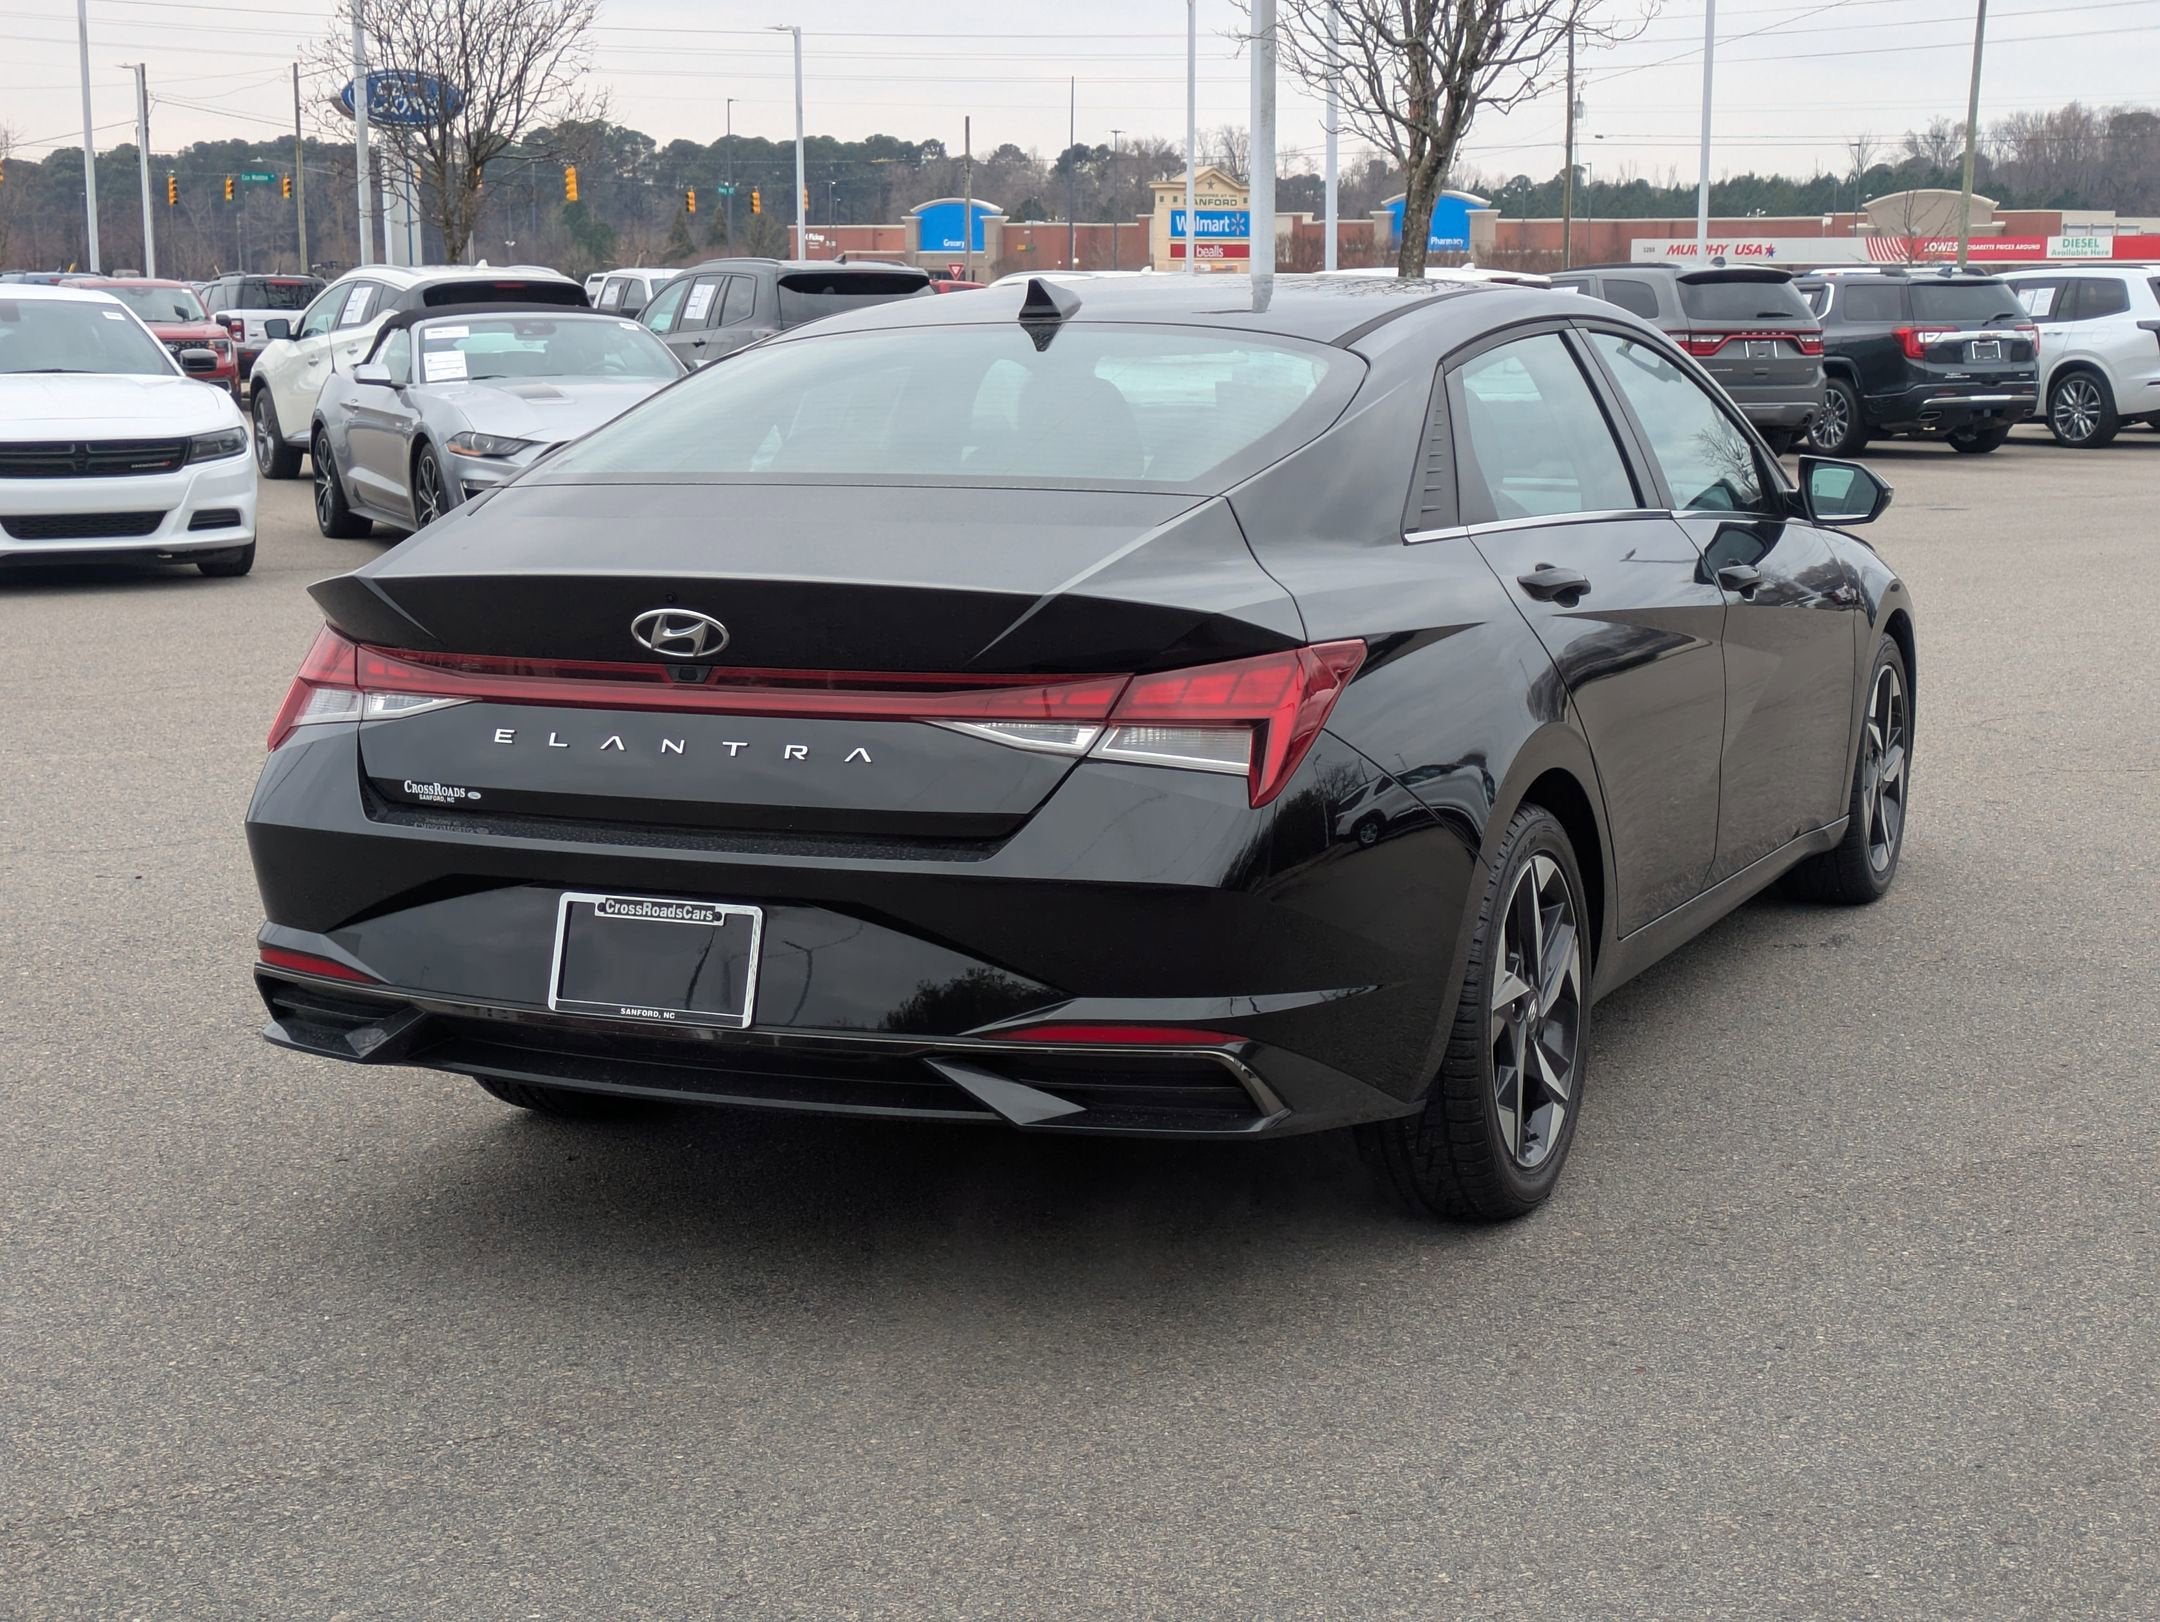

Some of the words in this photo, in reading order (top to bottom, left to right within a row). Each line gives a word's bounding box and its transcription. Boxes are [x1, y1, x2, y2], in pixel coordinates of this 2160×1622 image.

[1175, 215, 1230, 233] Wlmart
[943, 238, 965, 249] Grocery
[1430, 236, 1464, 248] Pharmacy
[2062, 238, 2100, 248] DIESEL
[1196, 244, 1224, 257] bealls
[1666, 244, 1729, 256] MURHY
[1733, 243, 1763, 256] USA
[2051, 248, 2088, 257] Available
[494, 728, 872, 763] ELANTRA
[605, 899, 714, 921] CrossRoadsCars
[620, 1007, 661, 1019] SANFORD,
[663, 1011, 676, 1019] NC
